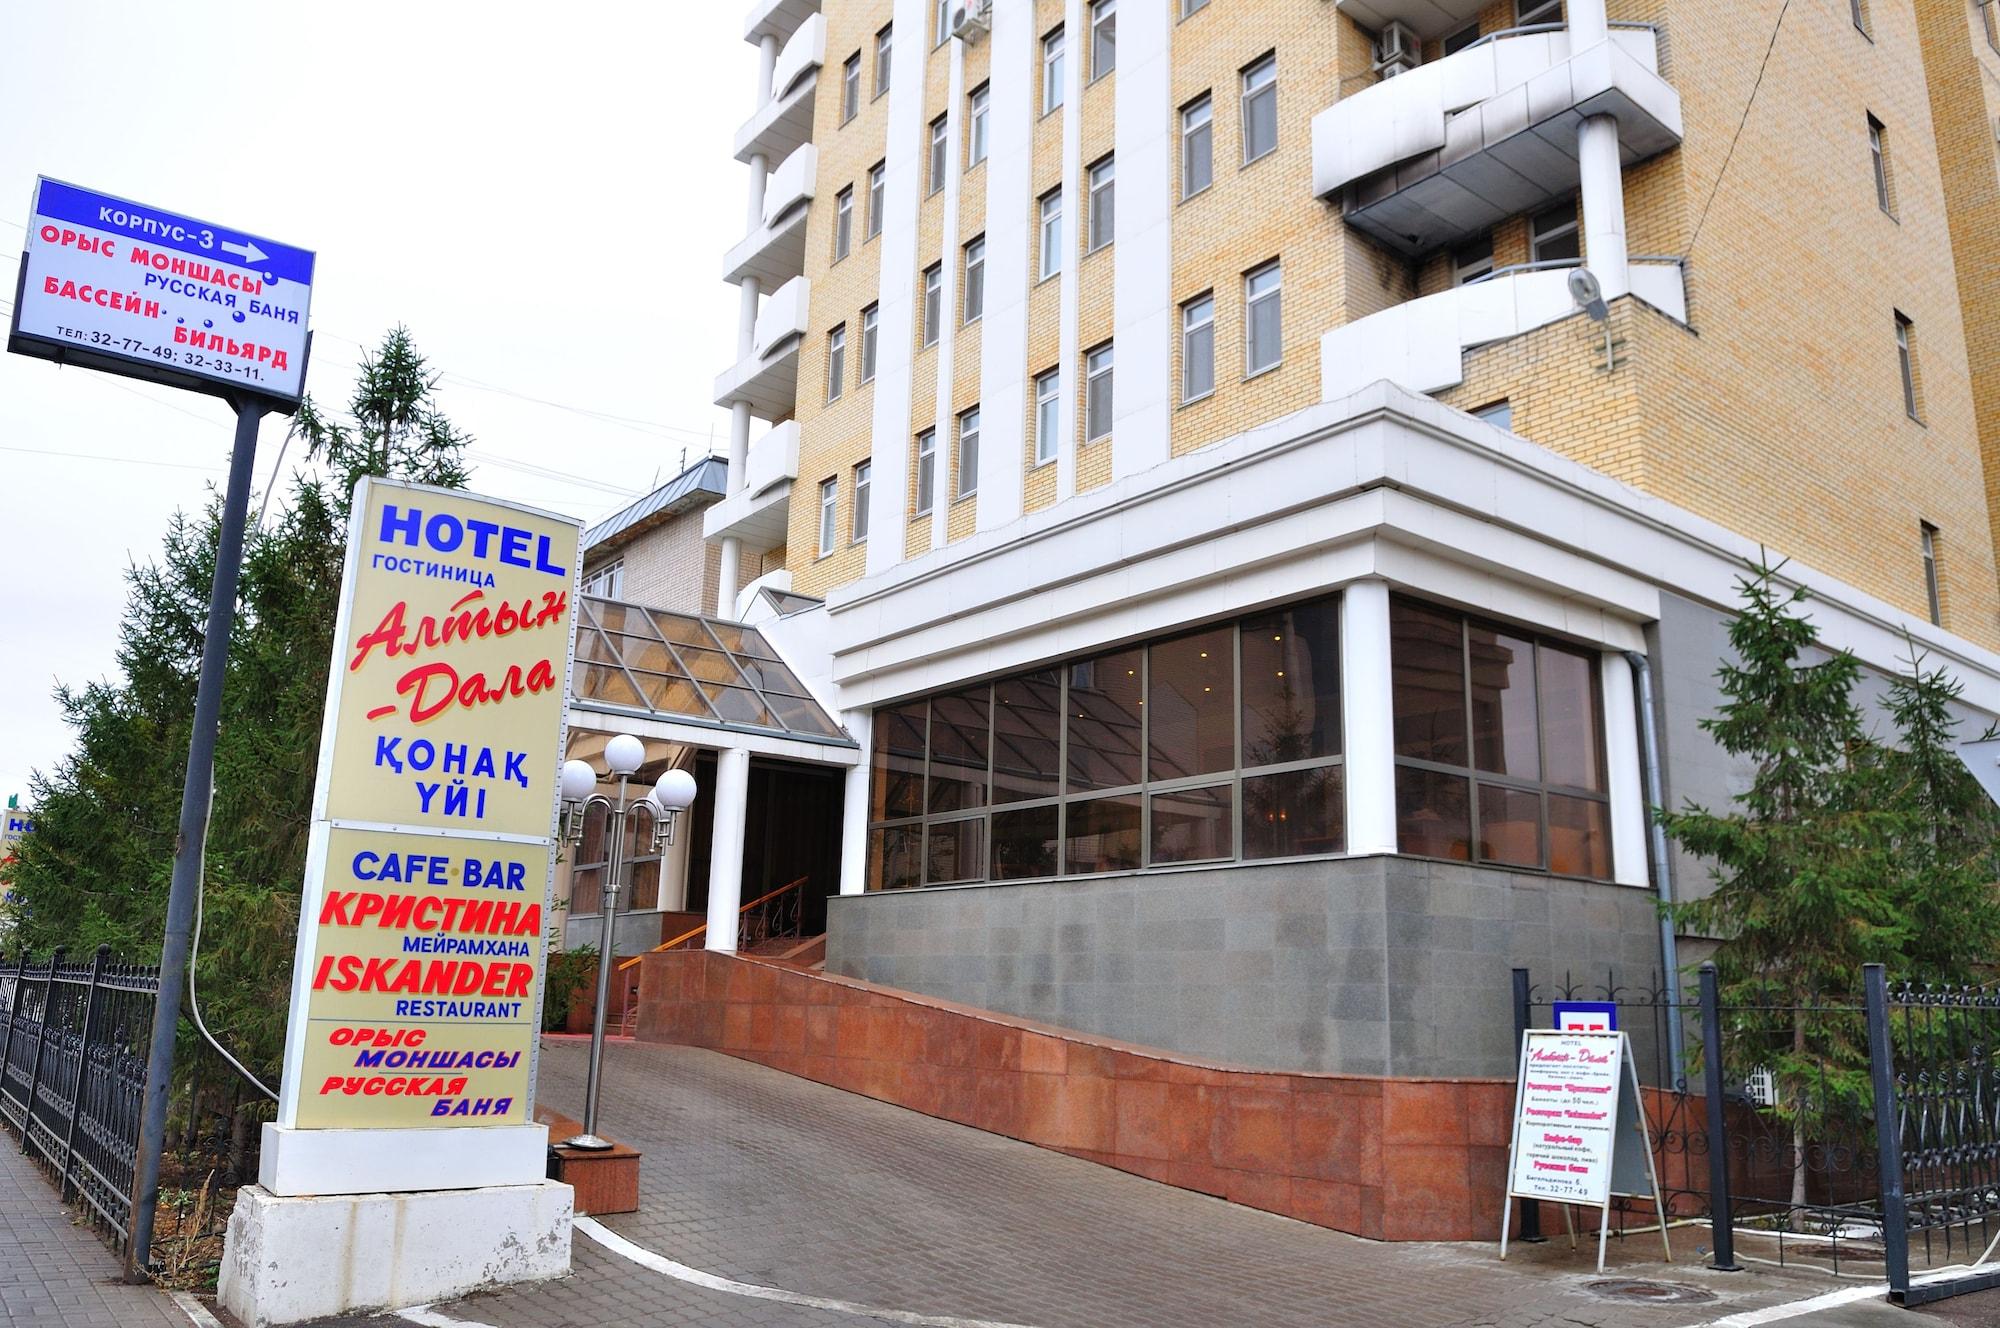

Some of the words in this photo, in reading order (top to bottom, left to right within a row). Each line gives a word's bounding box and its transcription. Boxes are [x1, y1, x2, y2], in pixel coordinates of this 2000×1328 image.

[99, 206, 214, 249] КОРПУС-3
[40, 225, 115, 257] ОРЫС
[130, 247, 263, 295] МОНШАСЫ
[44, 275, 160, 319] БАССЕЙН
[144, 272, 236, 308] РУССКАЯ
[249, 300, 299, 324] БАНЯ
[173, 326, 288, 371] БИЛЬЯРД
[184, 352, 265, 381] 32-33-11.
[379, 504, 567, 577] HOTEL
[372, 554, 496, 588] ГОСТИНИЦА
[350, 589, 568, 672] Алтын
[375, 735, 528, 788] ҚОНАҚ
[415, 778, 486, 819] ҮЙІ
[352, 851, 449, 885] CAFE
[463, 858, 525, 891] BAR
[319, 891, 542, 937] КРИСТИНА
[402, 933, 530, 957] МЕЙРАМХАНА
[312, 955, 534, 998] ISKANDER
[395, 1000, 522, 1018] RESTAURANT
[329, 1027, 427, 1048] ОРЫС
[354, 1050, 521, 1069] МОНШАСЫ
[320, 1076, 468, 1097] РУССКАЯ
[430, 1097, 513, 1117] БАНЯ
